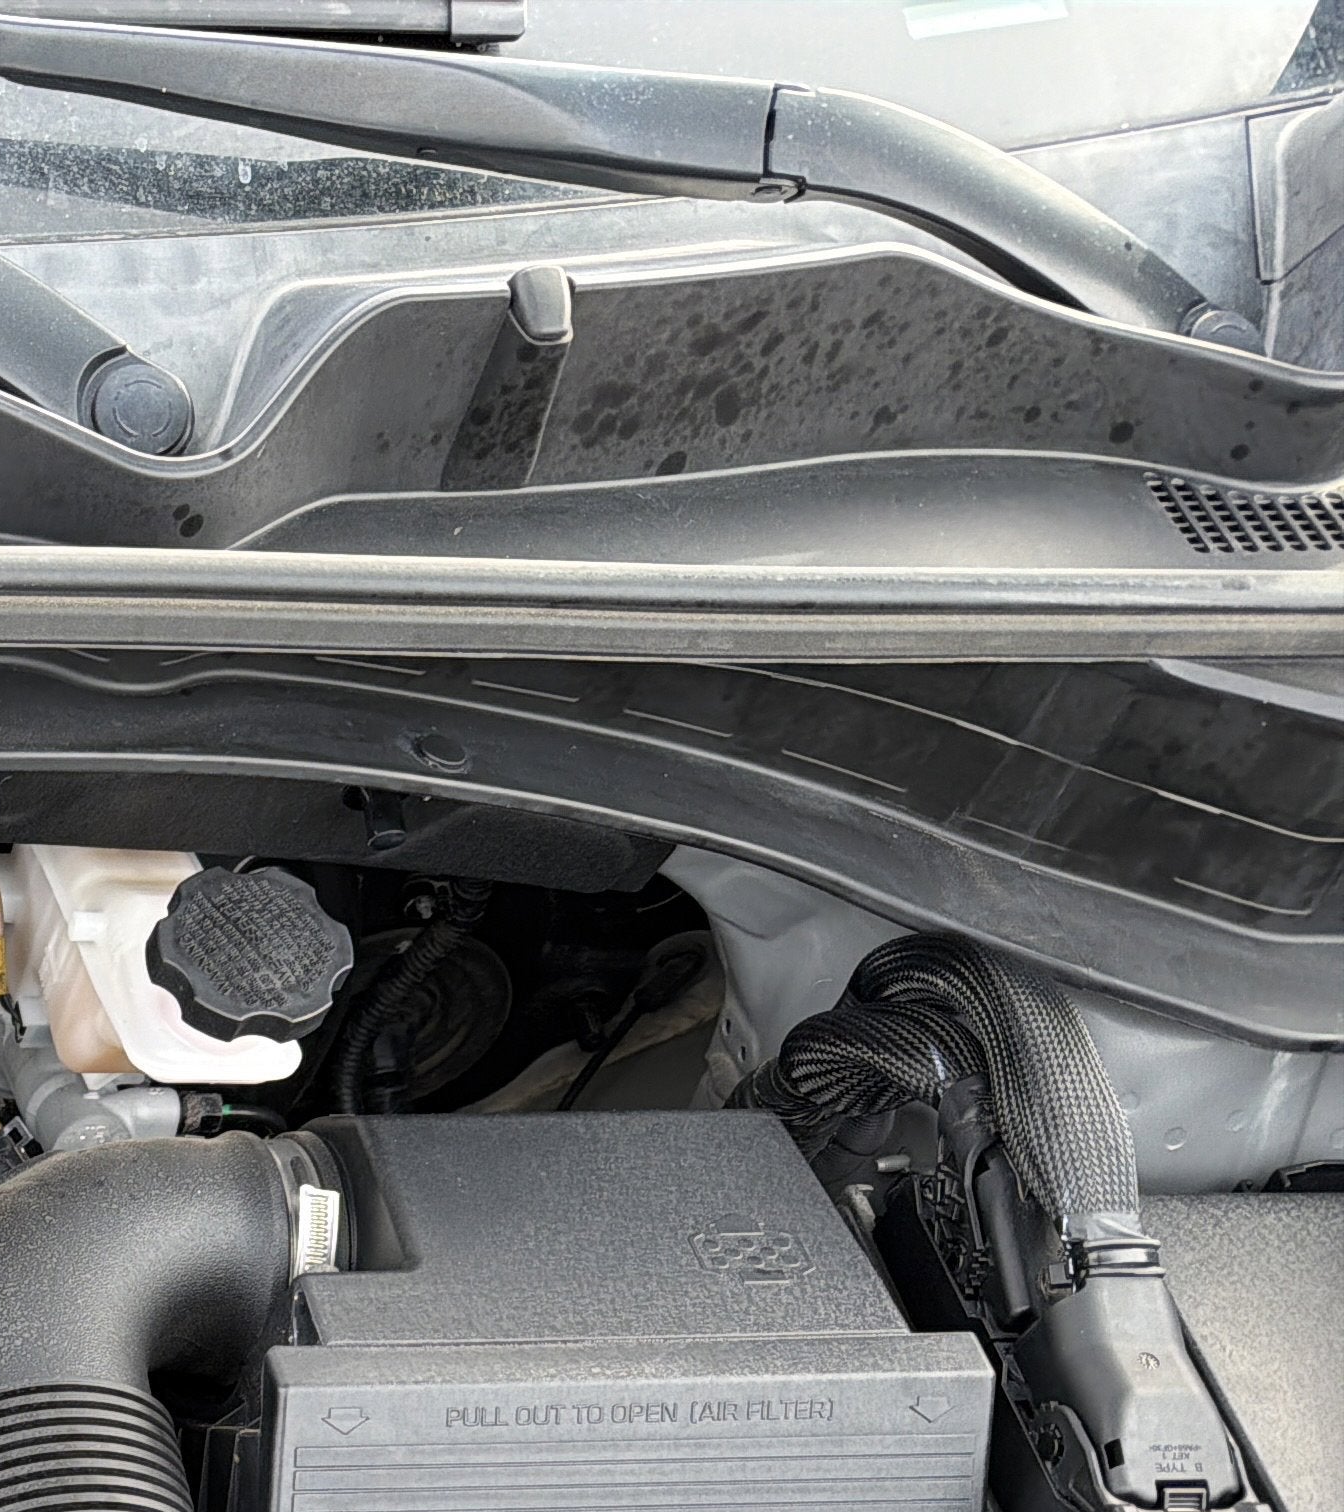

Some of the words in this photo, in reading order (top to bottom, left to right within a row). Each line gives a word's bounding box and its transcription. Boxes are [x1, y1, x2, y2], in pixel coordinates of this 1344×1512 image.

[445, 1404, 509, 1428] PULL
[515, 1403, 567, 1427] OUT
[572, 1403, 604, 1426] TO
[611, 1402, 679, 1424] OPEN
[1154, 1462, 1186, 1473] TYPE
[1193, 1462, 1203, 1473] B
